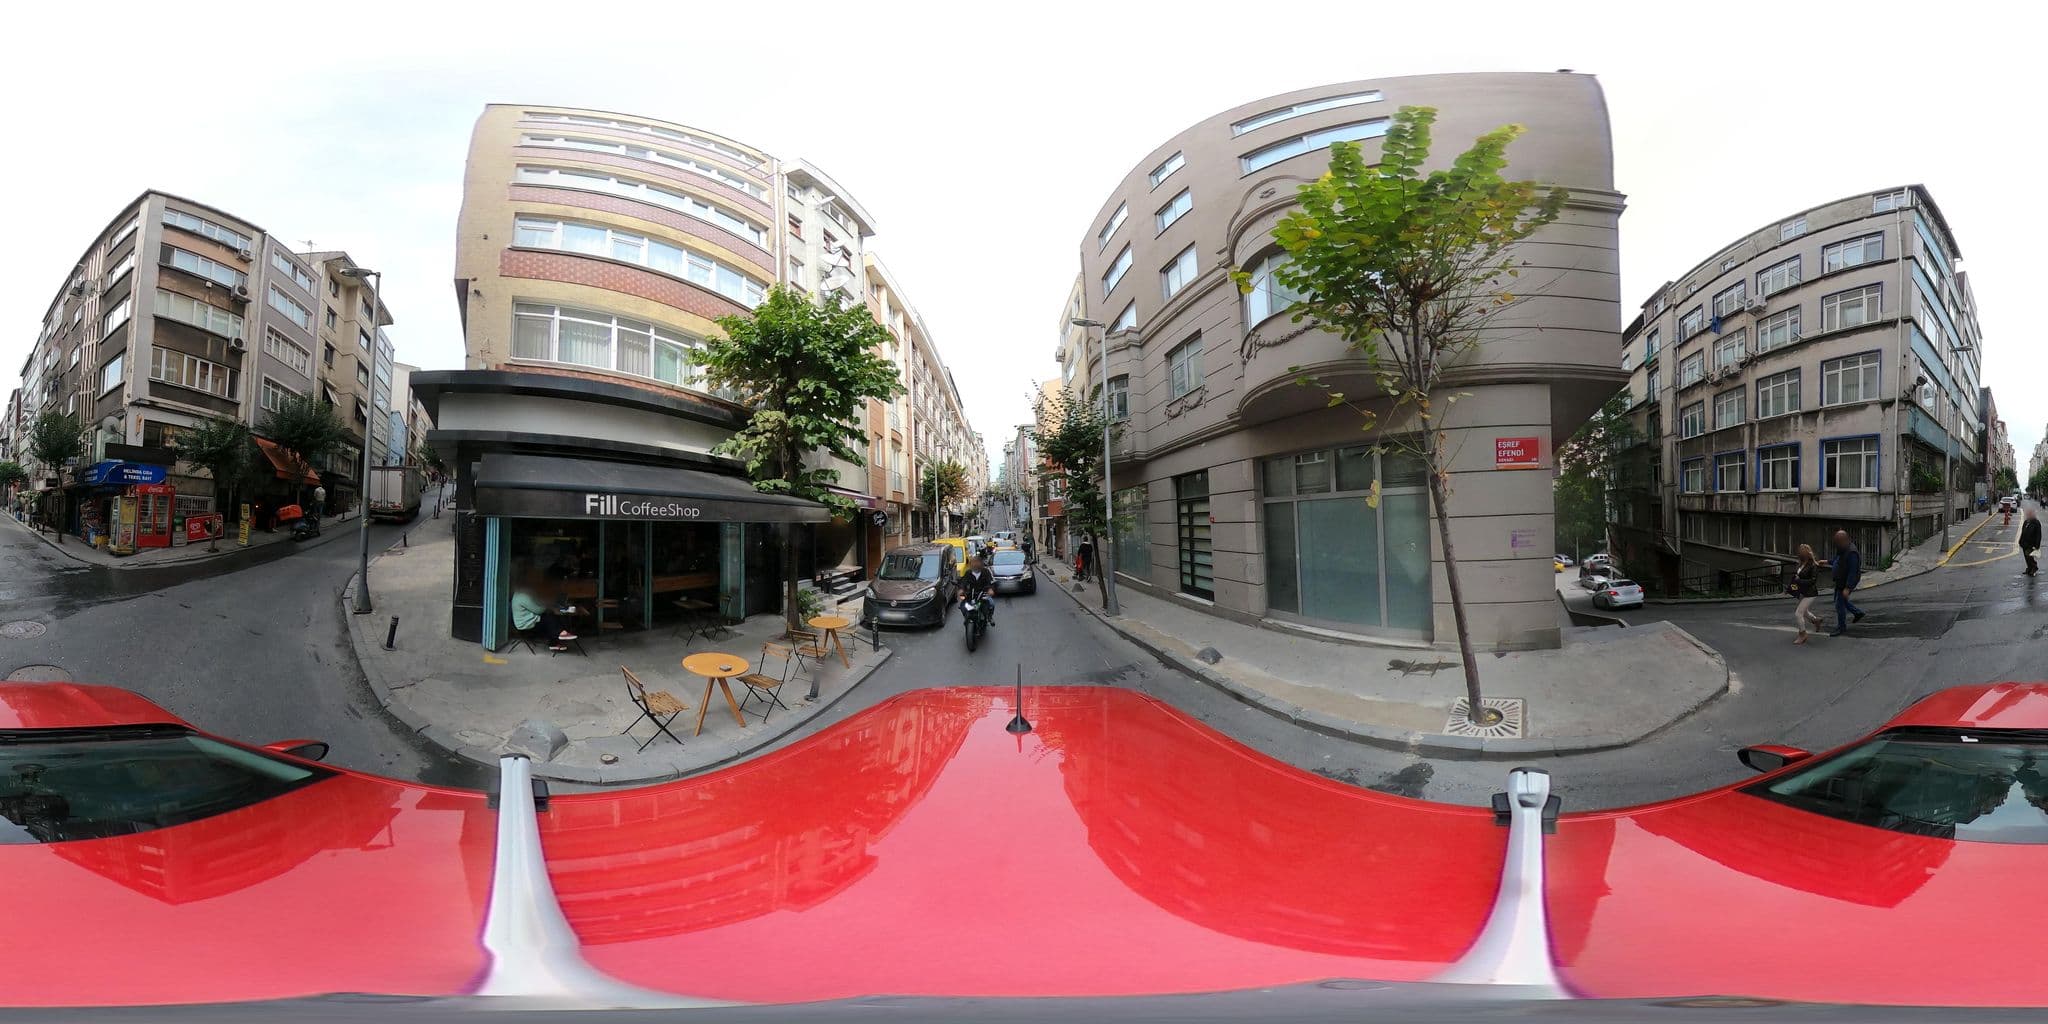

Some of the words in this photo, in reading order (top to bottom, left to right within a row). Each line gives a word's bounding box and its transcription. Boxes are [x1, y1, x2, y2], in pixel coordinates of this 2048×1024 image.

[1498, 441, 1520, 449] EŞREF
[1498, 448, 1524, 457] EFENDİ
[585, 494, 617, 515] Fill
